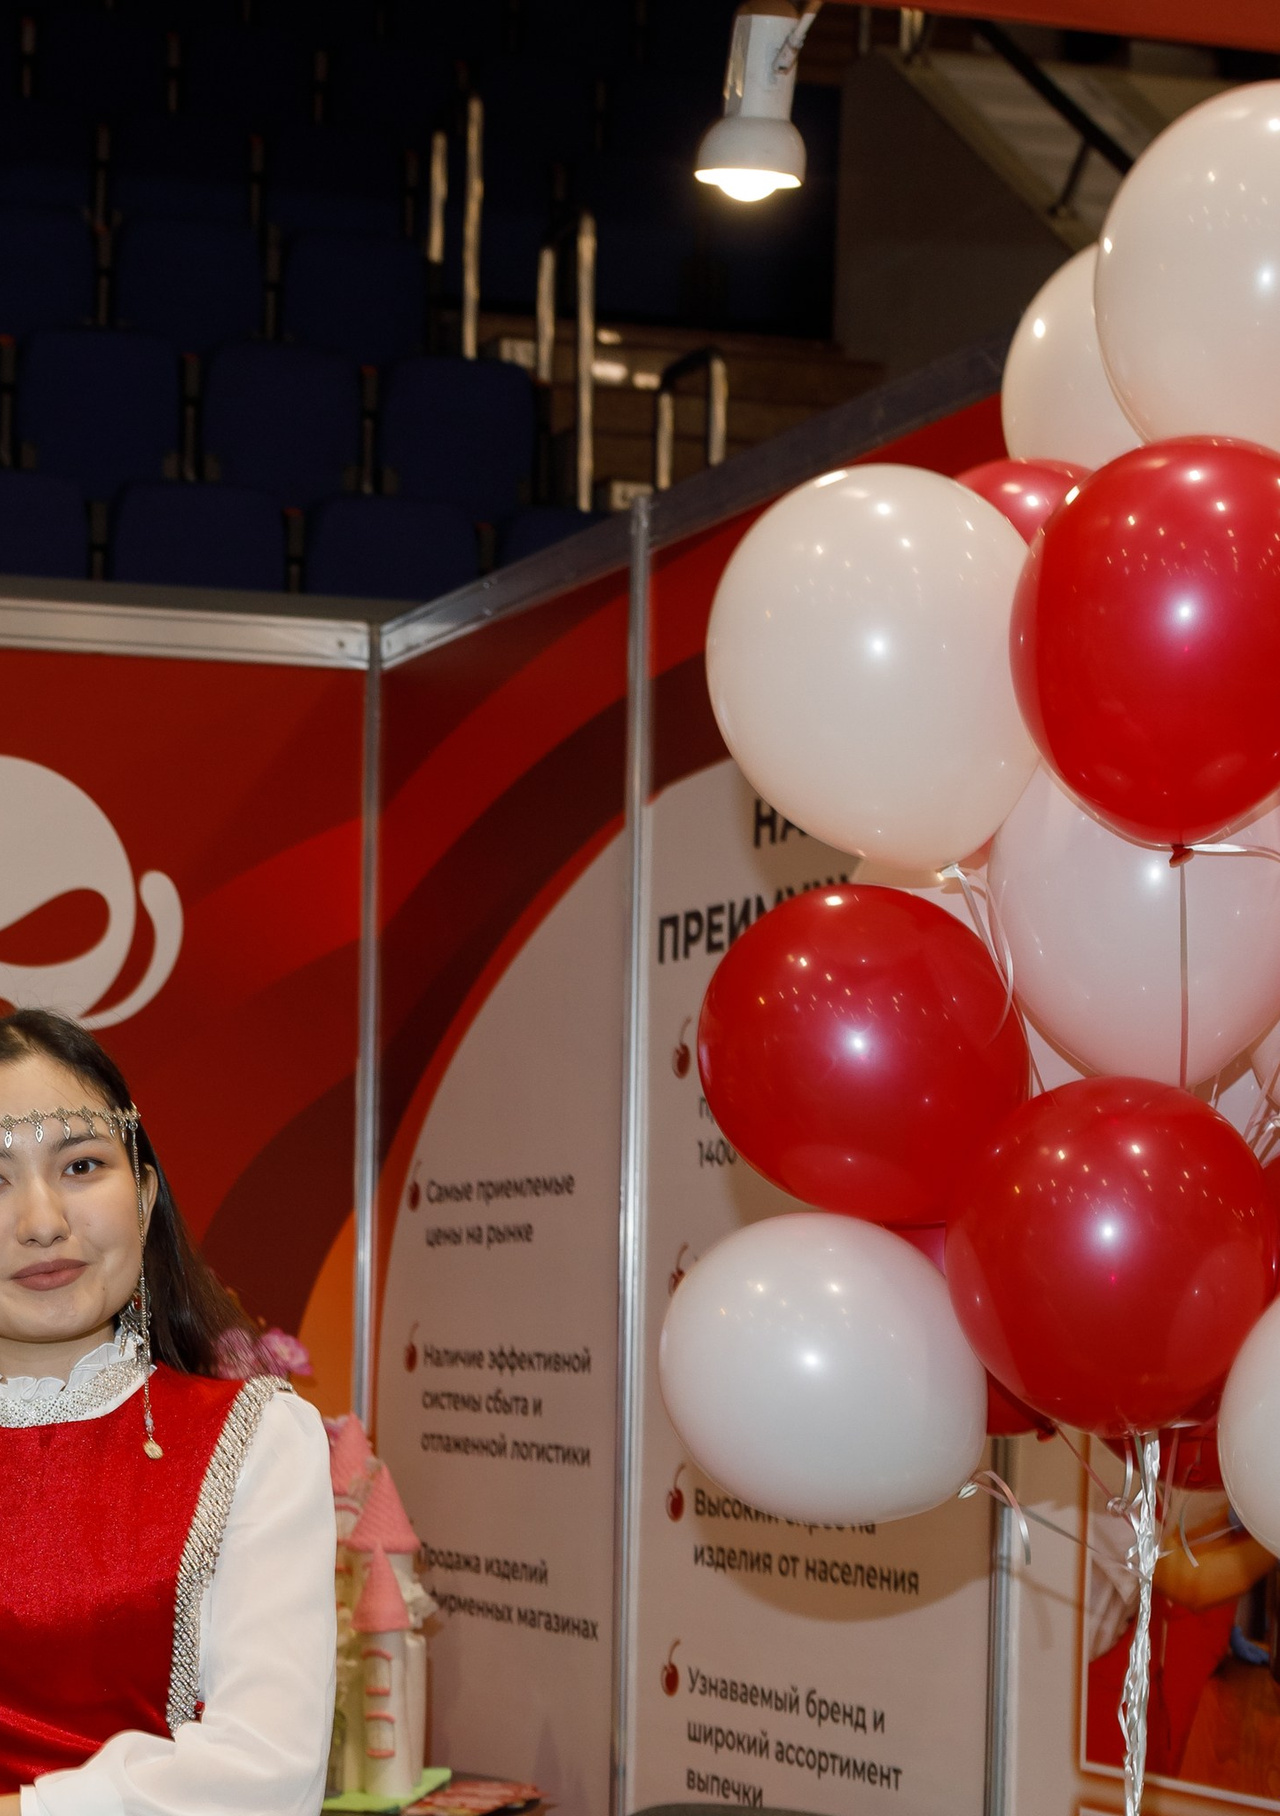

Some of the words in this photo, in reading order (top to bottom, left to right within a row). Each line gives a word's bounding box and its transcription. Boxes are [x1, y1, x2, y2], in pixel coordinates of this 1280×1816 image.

[426, 1179, 473, 1204] Самые
[477, 1174, 575, 1206] приемлемые
[426, 1225, 463, 1248] цены
[466, 1225, 483, 1245] на
[487, 1222, 533, 1250] рынке
[423, 1344, 484, 1369] Наличие
[488, 1344, 591, 1376] эффективной
[422, 1390, 481, 1414] системы
[485, 1387, 529, 1416] сбыта
[533, 1397, 543, 1417] и
[421, 1431, 507, 1459] отлаженной
[510, 1440, 591, 1468] логистики
[485, 1559, 548, 1586] изделий
[693, 1544, 773, 1576] изделия
[778, 1553, 800, 1579] от
[804, 1557, 920, 1596] населения
[517, 1606, 598, 1642] магазинах
[687, 1665, 800, 1716] Узнаваемый
[805, 1689, 867, 1735] бренд
[873, 1709, 886, 1734] и
[687, 1720, 769, 1760] широкий
[775, 1741, 903, 1791] ассортимент
[686, 1768, 764, 1808] выпечки
